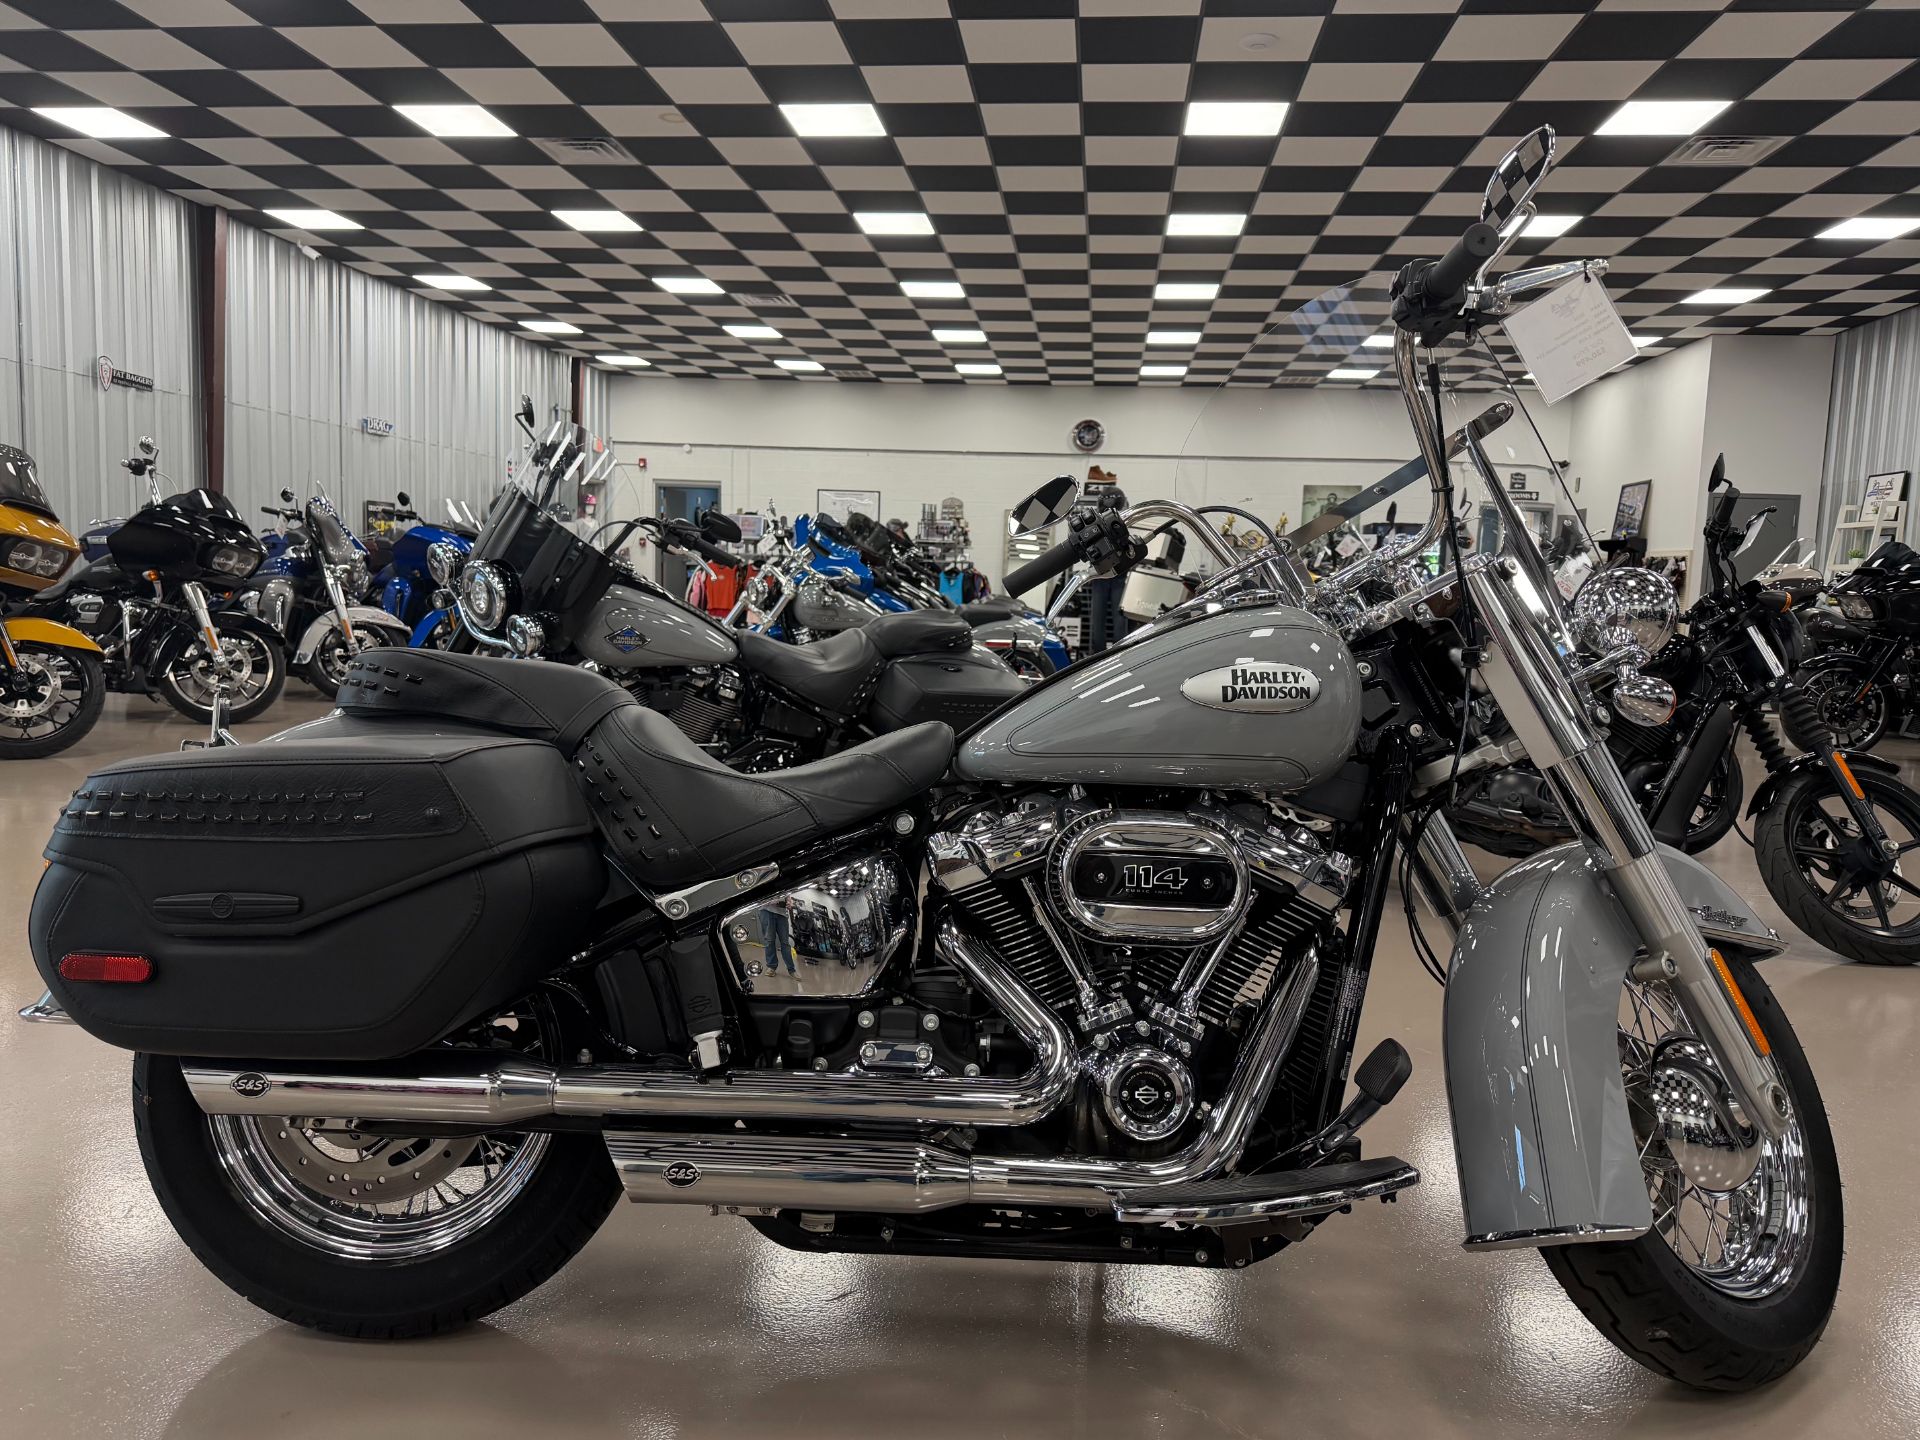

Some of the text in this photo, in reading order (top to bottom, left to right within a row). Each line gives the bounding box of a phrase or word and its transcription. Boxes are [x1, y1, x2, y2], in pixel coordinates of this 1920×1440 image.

[113, 369, 125, 378] FAT
[126, 373, 153, 386] BAGGERS
[368, 417, 390, 431] DRAG
[1222, 685, 1311, 702] DAVIDSON
[1123, 865, 1188, 889] 114
[237, 1080, 265, 1090] S&S
[667, 1168, 696, 1179] S&S
